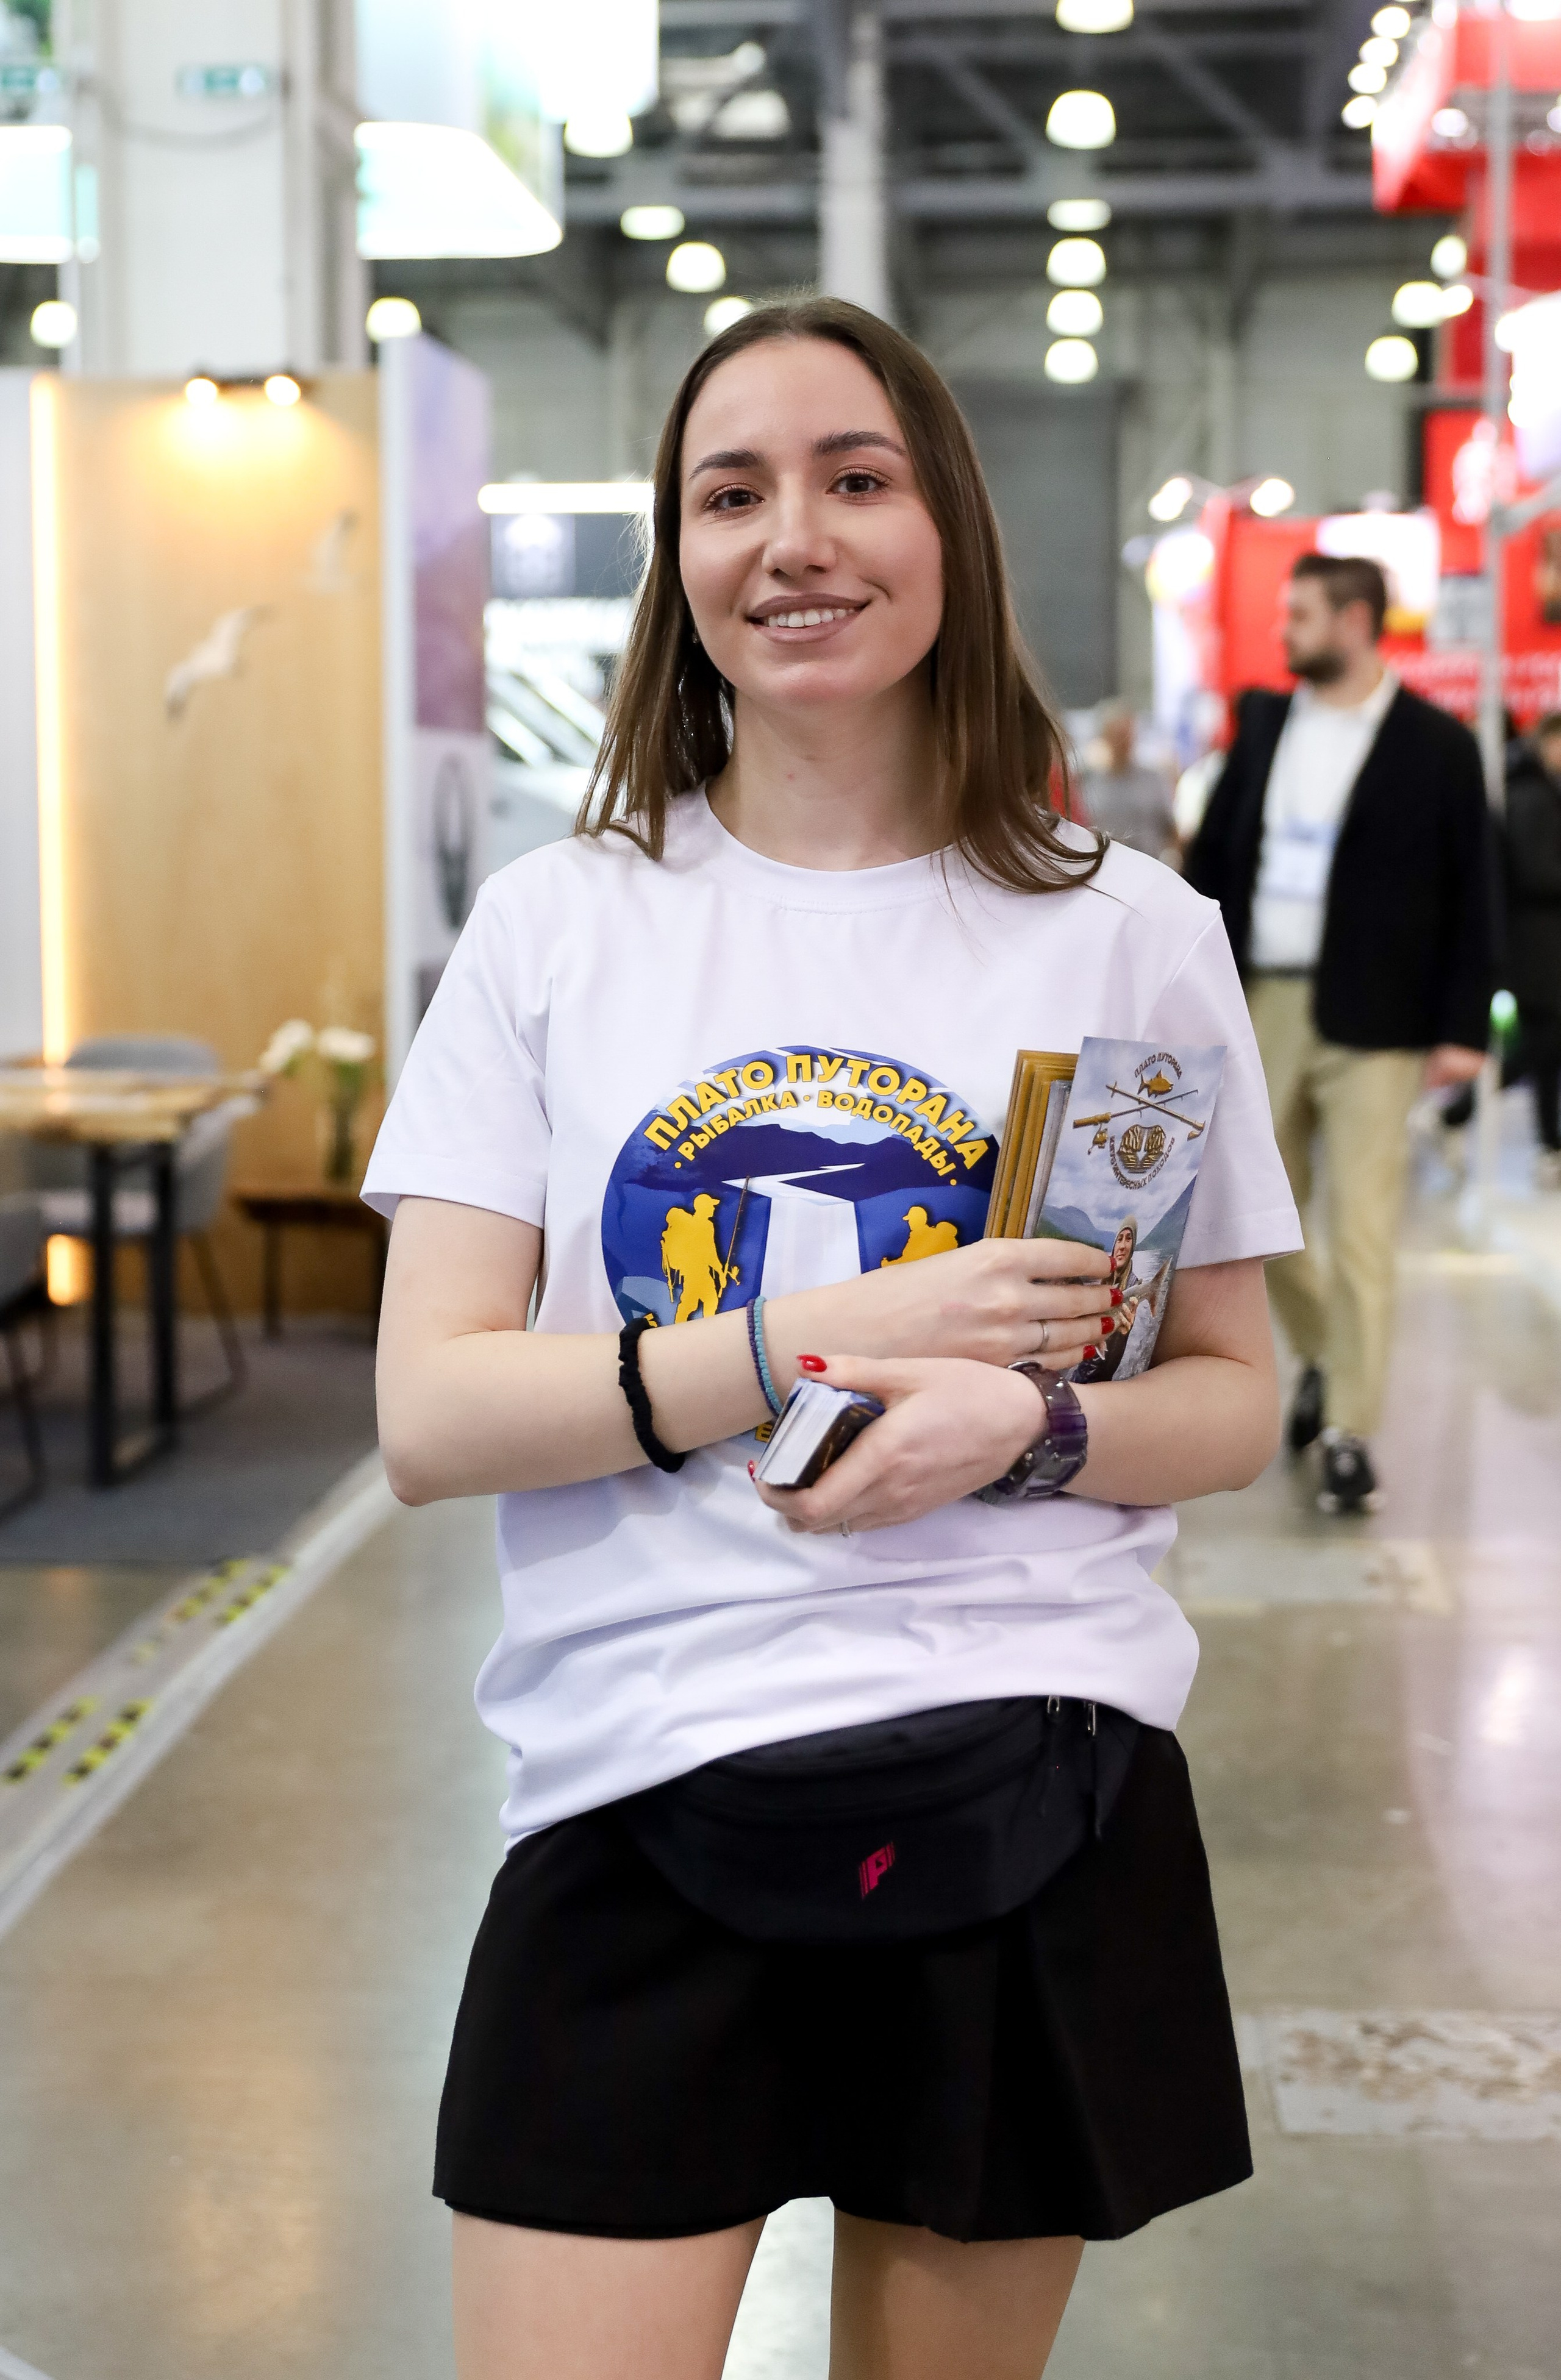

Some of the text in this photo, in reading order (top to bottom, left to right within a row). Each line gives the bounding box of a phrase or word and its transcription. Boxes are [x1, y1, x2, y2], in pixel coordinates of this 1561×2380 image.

[643, 1054, 990, 1170] ПЛАТО ПУТОРАНА
[677, 1090, 957, 1177] РЫБАЛКА ВОДОПАДЫ
